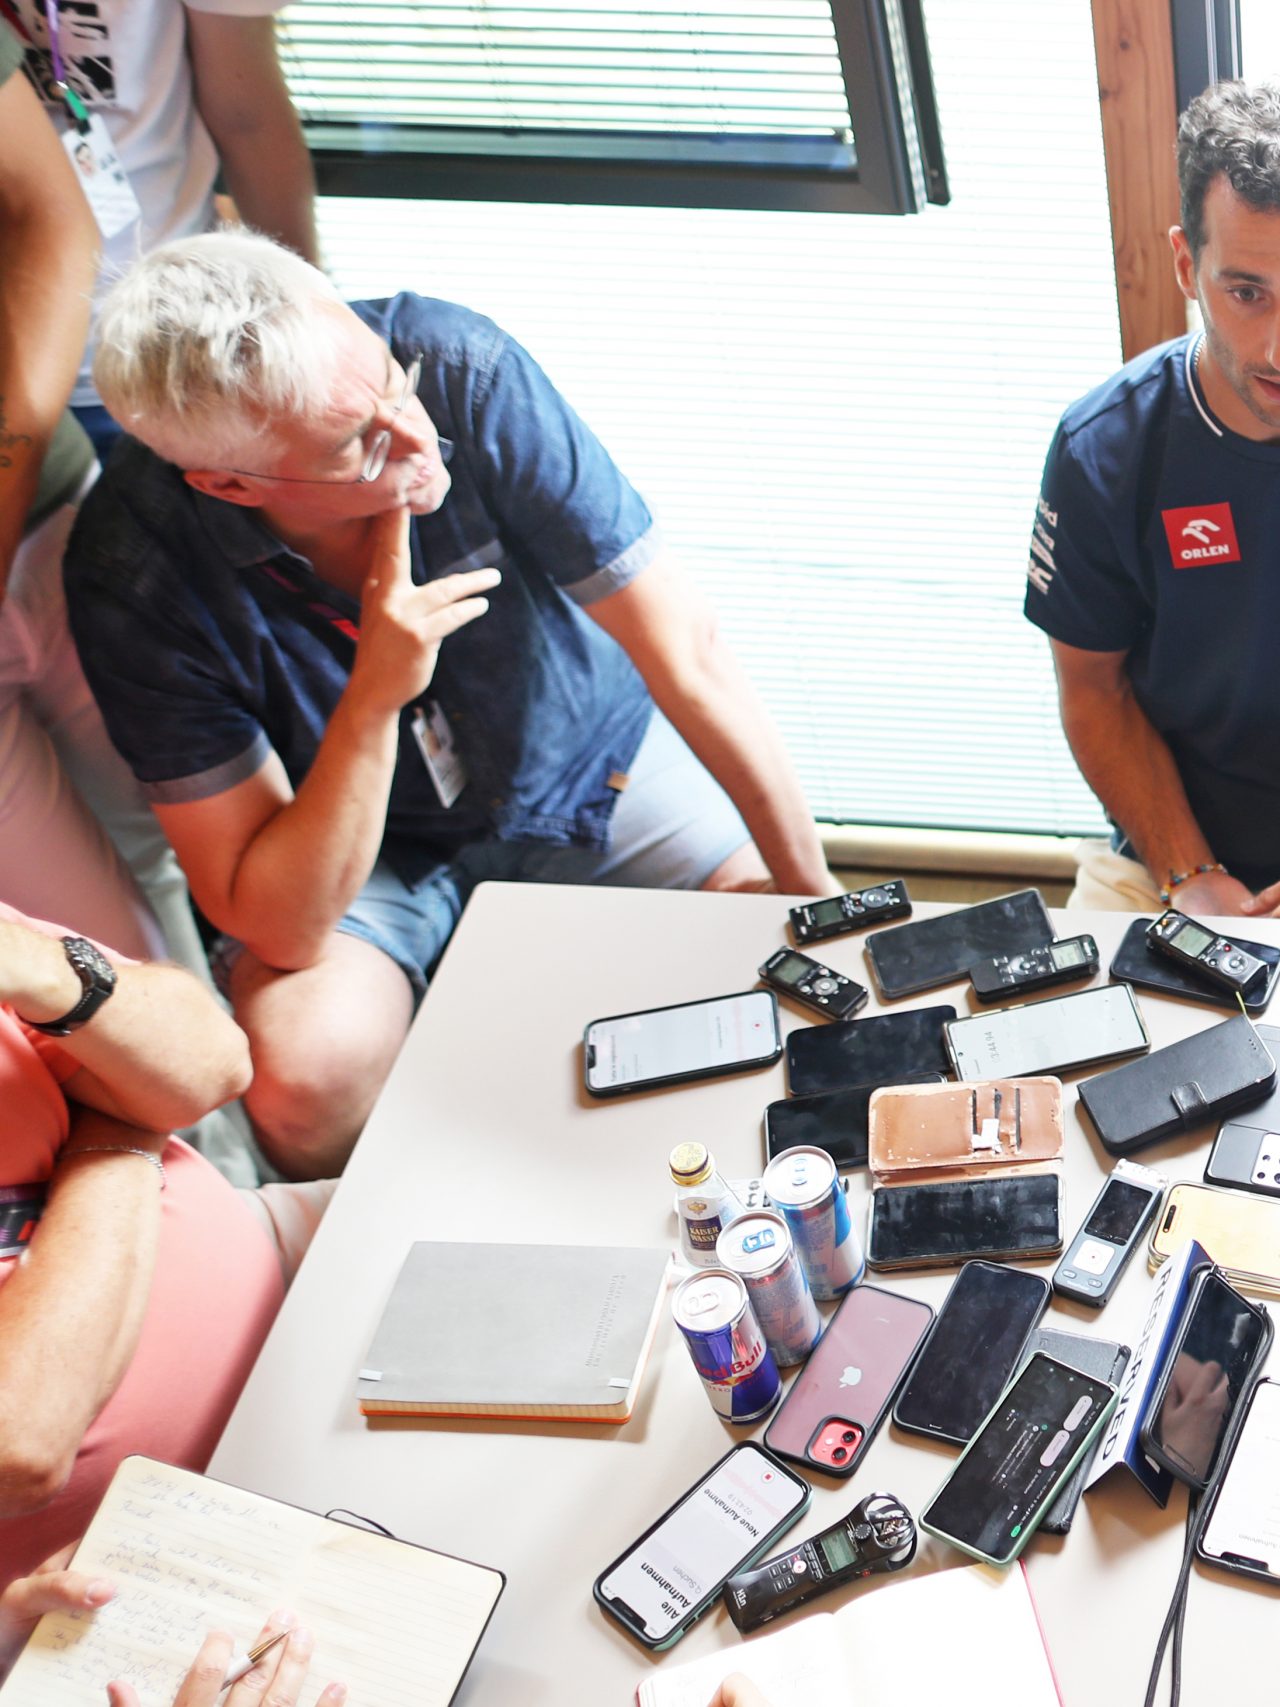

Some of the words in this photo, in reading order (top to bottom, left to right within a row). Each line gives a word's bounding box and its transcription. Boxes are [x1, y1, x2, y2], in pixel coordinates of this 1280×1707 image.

[1181, 544, 1229, 560] ORLEN
[730, 1341, 763, 1374] Bull
[1102, 1265, 1173, 1461] RESERVED
[703, 1488, 741, 1521] Aufnahme
[739, 1517, 759, 1538] Neue
[641, 1562, 692, 1609] Aufnahmen
[661, 1601, 680, 1620] Alle
